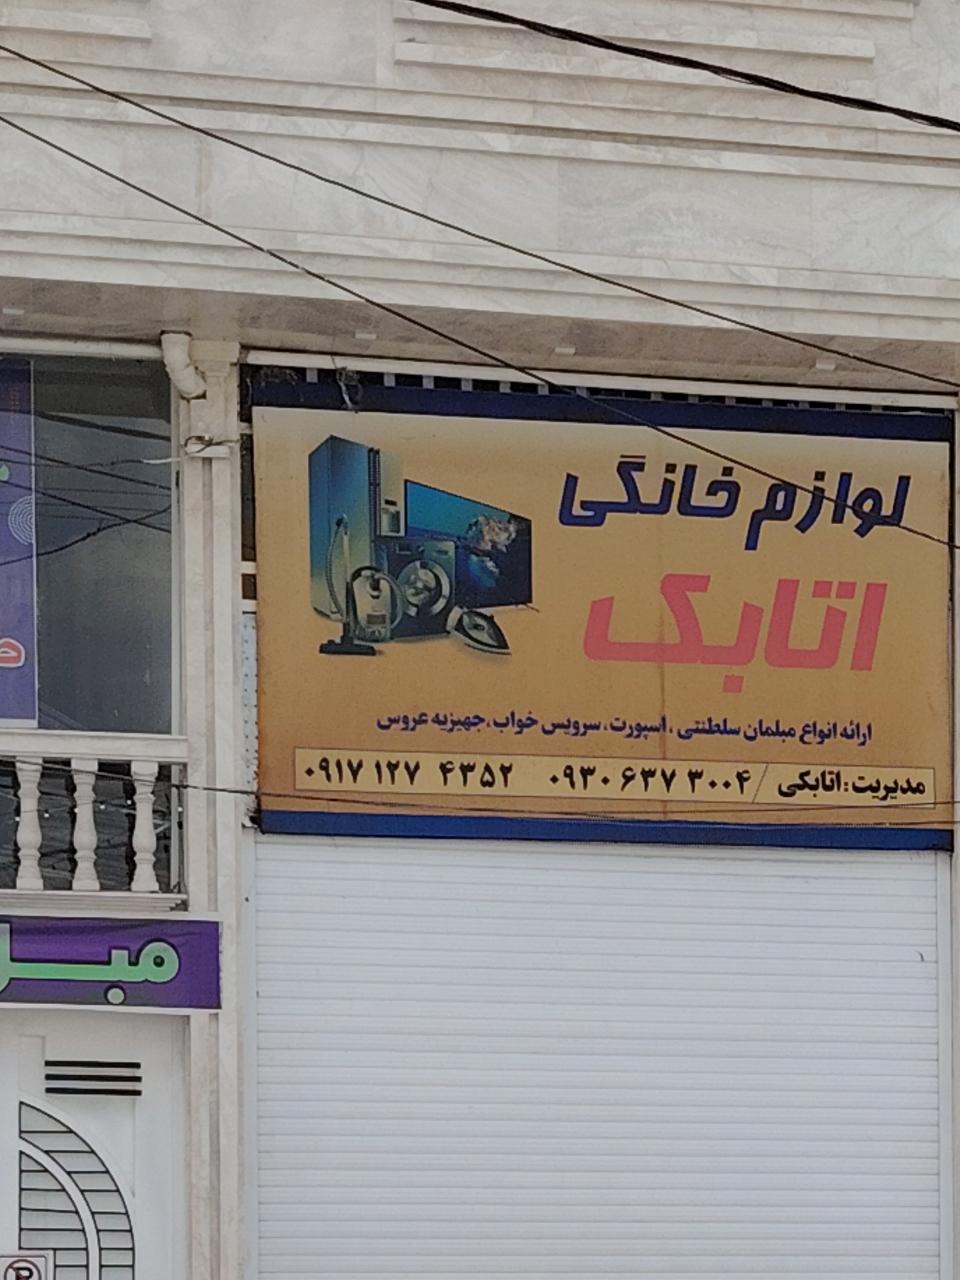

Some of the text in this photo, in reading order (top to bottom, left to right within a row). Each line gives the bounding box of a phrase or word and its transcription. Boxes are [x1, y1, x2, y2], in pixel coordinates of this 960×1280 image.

[558, 454, 912, 551] لوازم خانگی
[583, 573, 888, 694] اتابک
[376, 711, 428, 733] عروس
[541, 715, 601, 737] سرویس
[743, 718, 796, 743] مبلمان
[799, 721, 837, 744] انواع
[840, 720, 872, 746] ارائه
[438, 760, 513, 788] ۴۳۵۲
[777, 769, 842, 799] اتابکی
